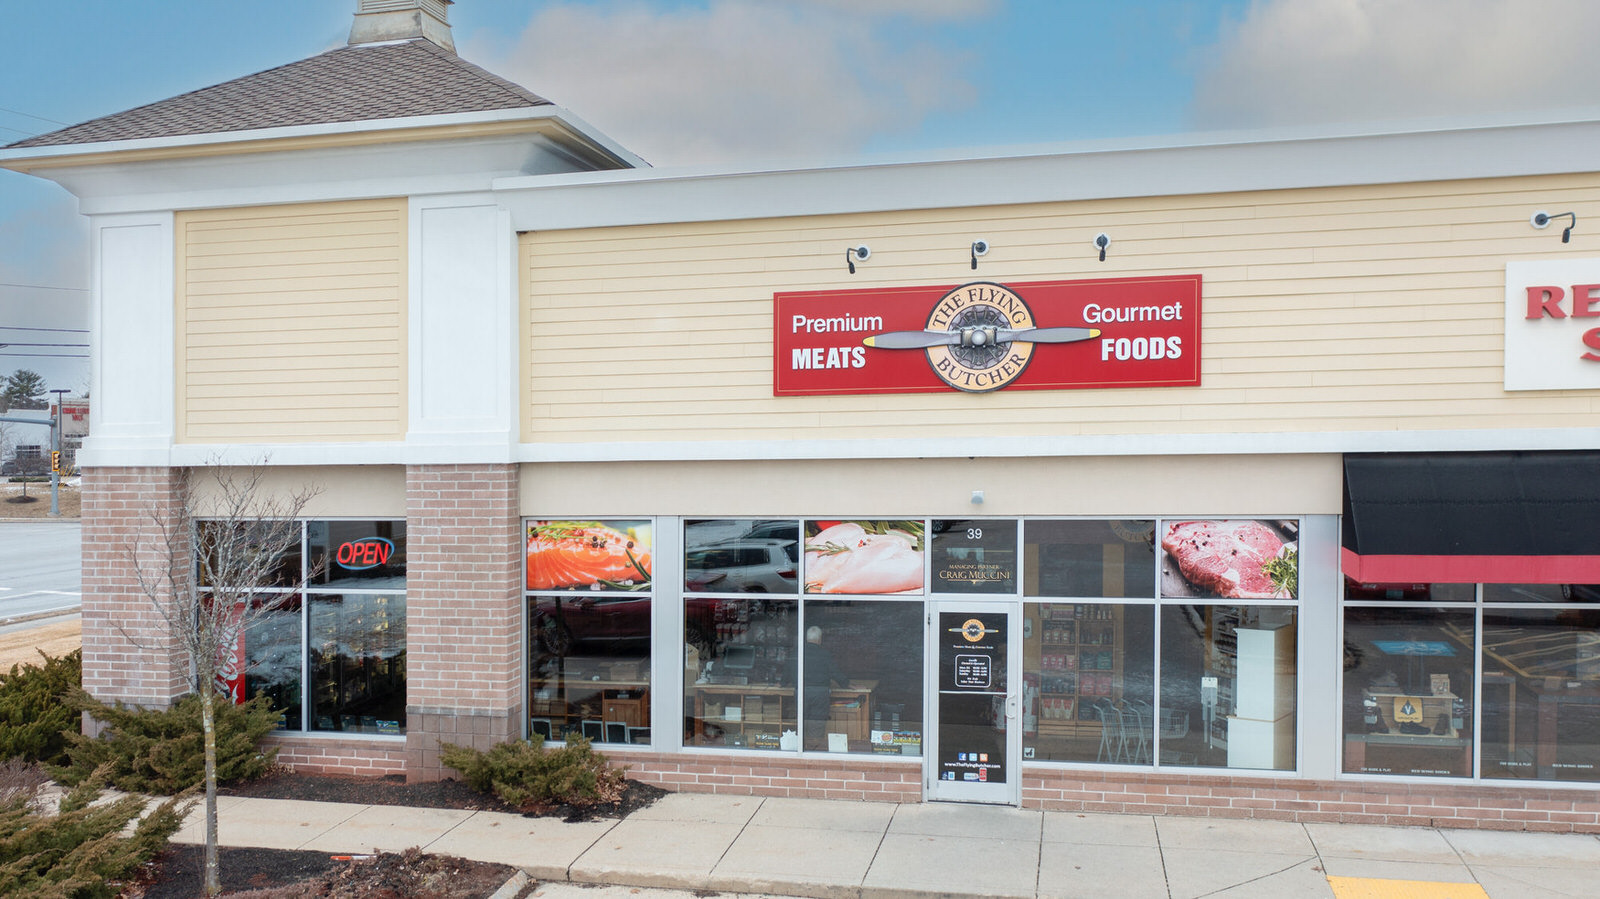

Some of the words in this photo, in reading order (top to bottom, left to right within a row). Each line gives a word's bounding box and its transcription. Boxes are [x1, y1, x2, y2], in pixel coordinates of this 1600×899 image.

[932, 294, 965, 327] THE
[967, 288, 1026, 324] FLYING
[1083, 301, 1182, 324] Gourmet
[792, 313, 883, 333] Premium
[792, 346, 866, 370] MEATS
[1101, 336, 1182, 361] FOODS
[936, 353, 1026, 386] BUTCHER
[967, 528, 983, 540] 39
[337, 542, 389, 565] OPEN
